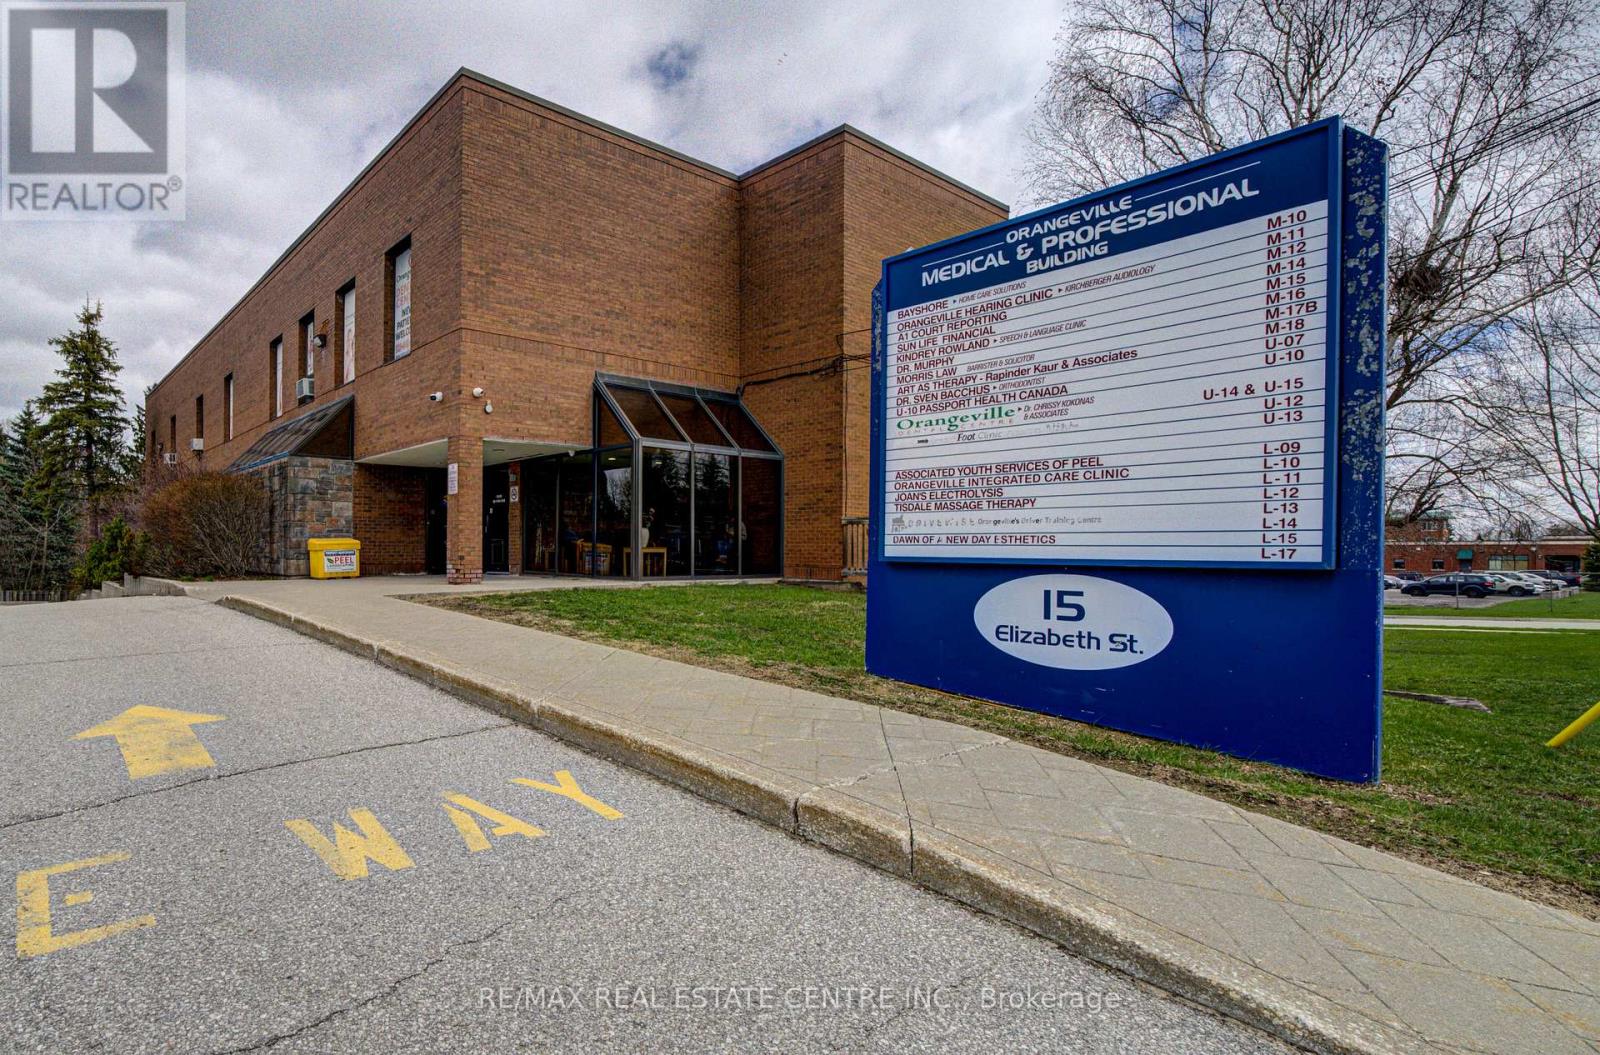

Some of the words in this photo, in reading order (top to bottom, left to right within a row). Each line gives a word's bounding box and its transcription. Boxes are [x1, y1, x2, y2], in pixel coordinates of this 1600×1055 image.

[1006, 195, 1132, 243] ORANGEVILLE
[1267, 210, 1307, 230] M-10
[922, 250, 1010, 287] MEDICAL
[1016, 242, 1034, 261] &
[1042, 178, 1260, 254] PROFESSIONAL
[1267, 227, 1305, 246] M-11
[1026, 241, 1109, 274] BUILDING
[1267, 242, 1306, 260] M-12
[1267, 257, 1306, 275] M-14
[1266, 273, 1306, 290] M-15
[897, 309, 962, 332] ORANGEVILLE
[965, 298, 1013, 317] HEARING
[1015, 288, 1053, 305] CLINIC
[1113, 264, 1156, 281] AUDIOLOGY
[897, 299, 948, 319] BAYSHORE
[959, 294, 976, 304] HOME
[977, 290, 993, 298] CARE
[993, 281, 1027, 296] SOLUTIONS
[1266, 288, 1306, 305] M-16
[1266, 301, 1318, 320] M-17B
[898, 330, 908, 341] A1
[911, 325, 944, 339] COURT
[947, 311, 1008, 331] REPORTING
[1265, 318, 1305, 335] M-18
[896, 349, 937, 363] KINDREY
[939, 339, 990, 356] ROWLAND
[1000, 331, 1023, 343] SPEECH
[1029, 324, 1065, 338] LANGUAGE
[1065, 320, 1087, 330] CLINIC
[897, 342, 917, 352] SUN
[919, 337, 938, 348] LIFE
[942, 326, 995, 344] FINANCIAL
[1265, 334, 1305, 350] U-07
[896, 365, 911, 374] DR.
[914, 356, 955, 370] MURPHY
[897, 372, 933, 384] MORRIS
[936, 367, 957, 378] LAW
[967, 361, 998, 372] BARRISTER
[1005, 354, 1035, 366] SOLICITOR
[897, 386, 915, 395] ART
[918, 383, 930, 391] AS
[933, 375, 977, 389] THERAPY
[986, 366, 1031, 381] Rapinder
[1034, 362, 1059, 373] Kaur
[1061, 359, 1069, 369] &
[1073, 349, 1138, 367] Associates
[896, 397, 912, 406] DR.
[914, 392, 938, 404] SVEN
[941, 384, 990, 400] BACCHUS
[998, 377, 1046, 390] ORTHODONTIST
[1203, 386, 1239, 400] U-14
[1245, 384, 1255, 395] &
[1264, 377, 1304, 393] U-15
[920, 400, 971, 414] PASSPORT
[974, 392, 1016, 406] HEALTH
[1019, 385, 1068, 400] CANADA
[1264, 395, 1303, 410] U-12
[897, 407, 1015, 431] Orangeville
[1033, 401, 1061, 411] CHRISSY
[1029, 409, 1069, 420] ASSOCIATES
[1264, 410, 1303, 424] U-13
[1264, 442, 1300, 454] L-09
[895, 468, 956, 480] ASSOCIATED
[957, 465, 992, 476] YOUTH
[995, 460, 1050, 473] SERVICES
[1052, 459, 1069, 469] OF
[1072, 457, 1104, 468] PEEL
[1264, 457, 1300, 469] L-10
[894, 478, 966, 490] ORANGEVILLE
[968, 473, 1041, 487] INTEGRATED
[1044, 471, 1079, 483] CARE
[1083, 468, 1130, 480] CLINIC
[1263, 472, 1300, 485] L-11
[929, 488, 1004, 500] ELECTROLYSIS
[1263, 487, 1299, 499] L-12
[894, 502, 932, 512] TISDALE
[934, 500, 983, 511] MASSAGE
[986, 498, 1037, 509] THERAPY
[1263, 503, 1299, 514] L-13
[1263, 518, 1297, 529] L-14
[893, 536, 920, 544] DAWN
[922, 536, 935, 544] OF
[946, 536, 969, 544] NEW
[971, 536, 992, 544] DAY
[1262, 533, 1297, 544] L-15
[1261, 548, 1297, 560] L-17
[1043, 589, 1086, 622] 15
[995, 624, 1101, 651] Elizabeth
[1108, 632, 1144, 654] St.
[284, 770, 624, 881] WAY
